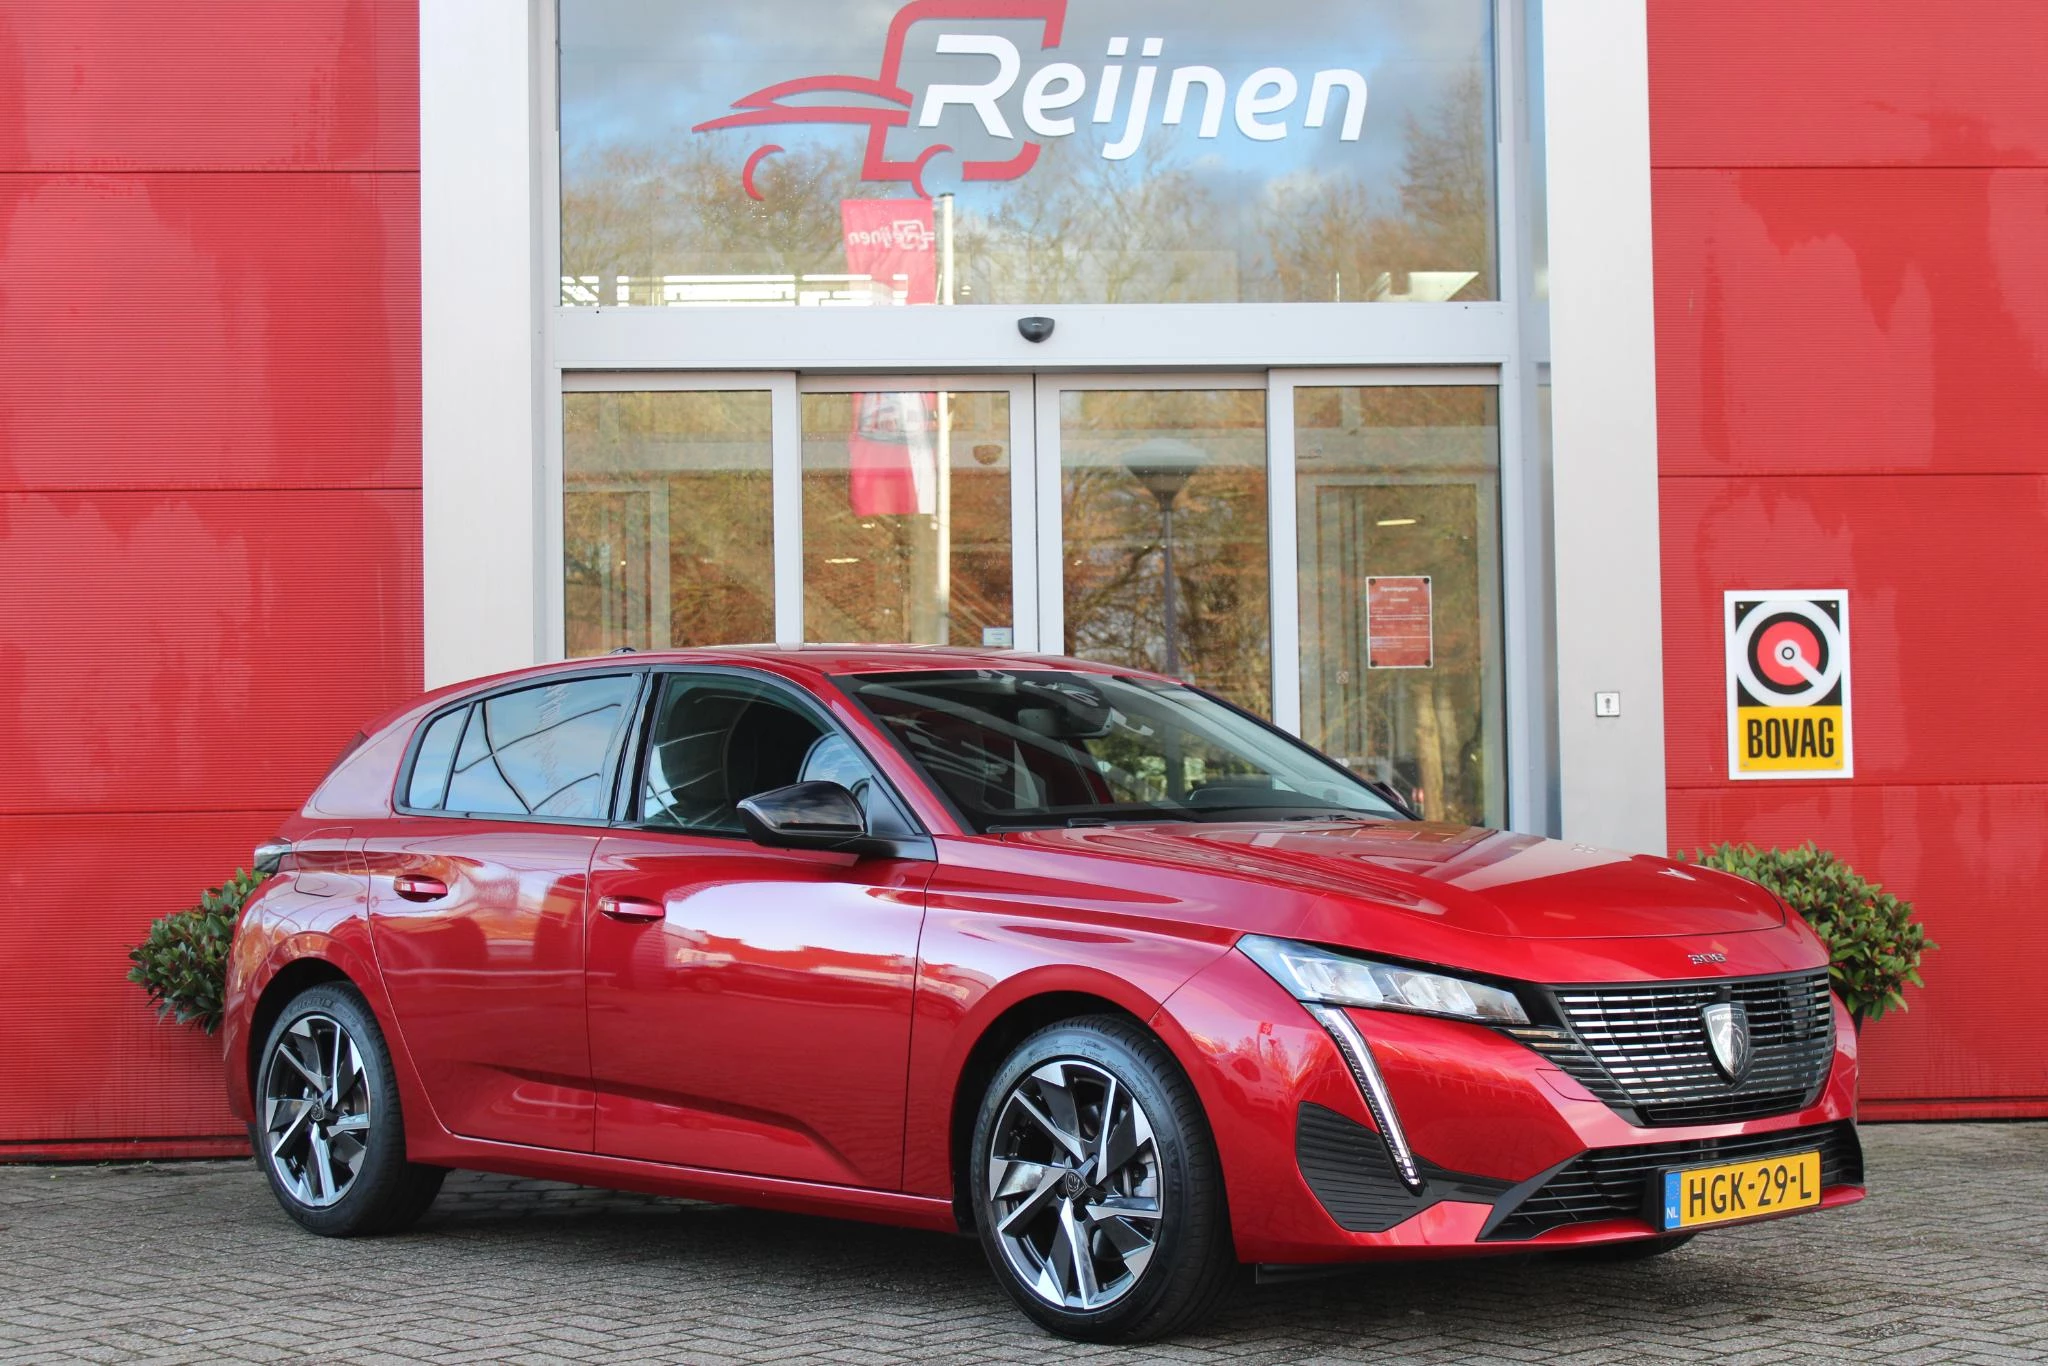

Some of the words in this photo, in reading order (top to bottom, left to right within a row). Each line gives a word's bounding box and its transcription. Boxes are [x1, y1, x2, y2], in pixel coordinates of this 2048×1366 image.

[918, 34, 1369, 160] Reijnen
[1747, 717, 1834, 759] BOVAG
[1666, 1207, 1679, 1219] NL
[1689, 1162, 1812, 1218] HGK-29-L
